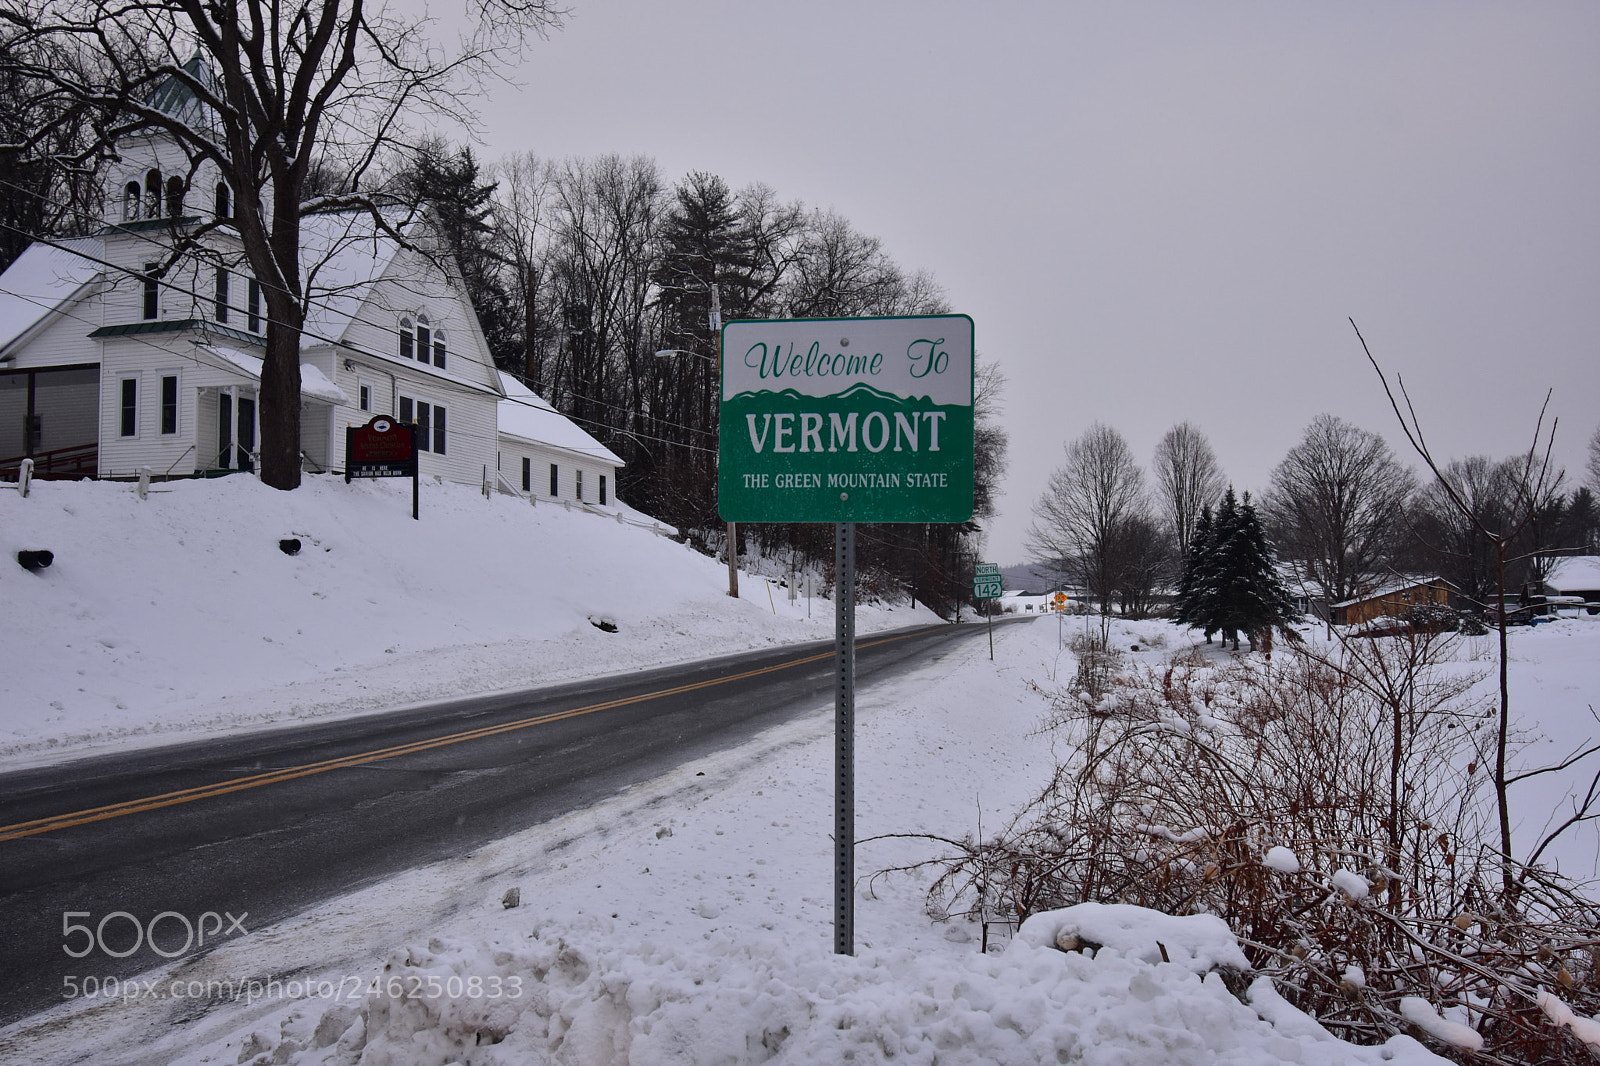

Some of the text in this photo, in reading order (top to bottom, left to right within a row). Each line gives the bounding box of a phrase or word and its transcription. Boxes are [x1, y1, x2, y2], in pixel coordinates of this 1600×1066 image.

[744, 338, 949, 379] Welcome To
[745, 411, 946, 453] VERMONT
[743, 473, 948, 488] THE GREEN MOUNTAIN STATE
[976, 566, 998, 574] NORTH
[977, 584, 999, 597] 142
